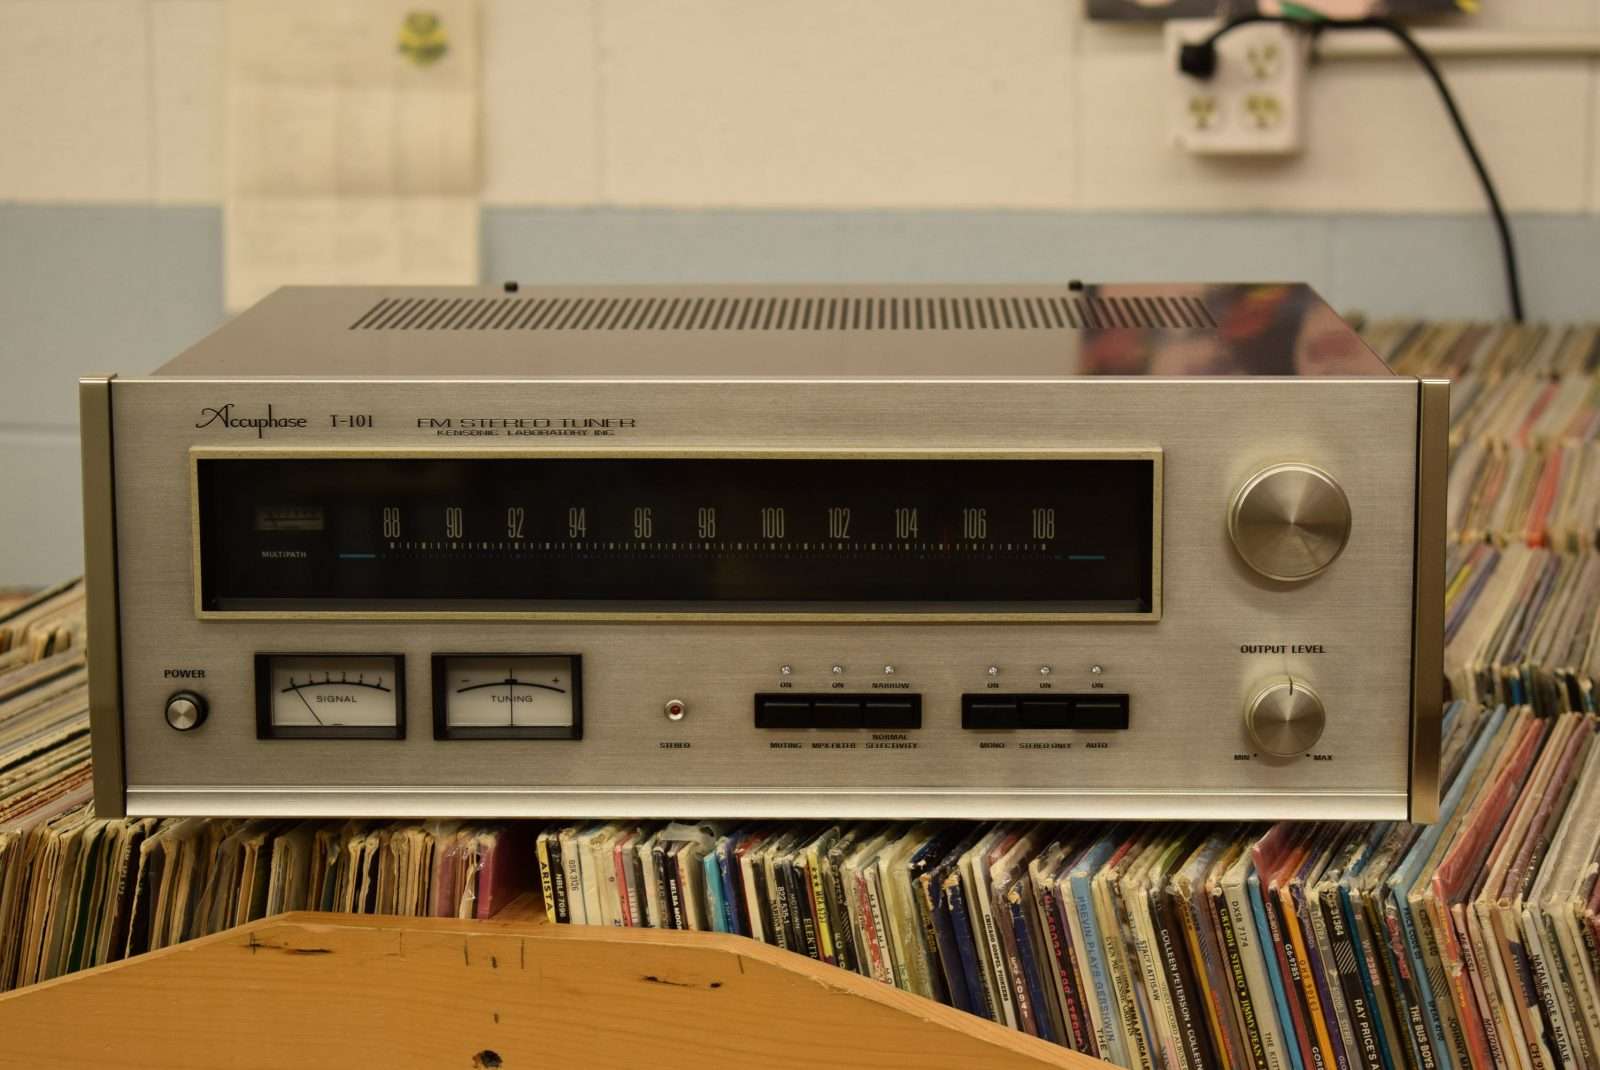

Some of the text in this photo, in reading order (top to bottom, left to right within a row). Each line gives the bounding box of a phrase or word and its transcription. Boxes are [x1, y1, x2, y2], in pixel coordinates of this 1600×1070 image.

[195, 404, 373, 438] Accuphase T-101
[417, 418, 636, 428] FM STEREO TUNER
[384, 508, 1055, 538] 88 90 92 94 96 98 100 102 104 106 108
[1240, 645, 1327, 654] OUTPUT LEVEL
[164, 670, 206, 678] POWER
[540, 861, 553, 911] ARISTA
[668, 878, 679, 906] MELBA
[1236, 925, 1249, 948] 7174
[984, 913, 1009, 1002] CHICAGO GOSPEL PIONEERS
[1076, 895, 1116, 1043] PREVIN PLAYS GERSHWIN
[1159, 927, 1178, 971] COLLEEN
[1171, 971, 1191, 1022] PETERSON
[1229, 952, 1245, 988] STEREO
[1248, 1029, 1262, 1057] DEAN
[1532, 953, 1571, 1064] NATALIE COLE NATALIE
[1095, 1027, 1107, 1051] THE
[1263, 1031, 1274, 1048] THE
[1352, 997, 1366, 1020] RAY
[1359, 1020, 1377, 1061] PRICE'S
[1408, 1005, 1434, 1069] THE BUS BOYS
